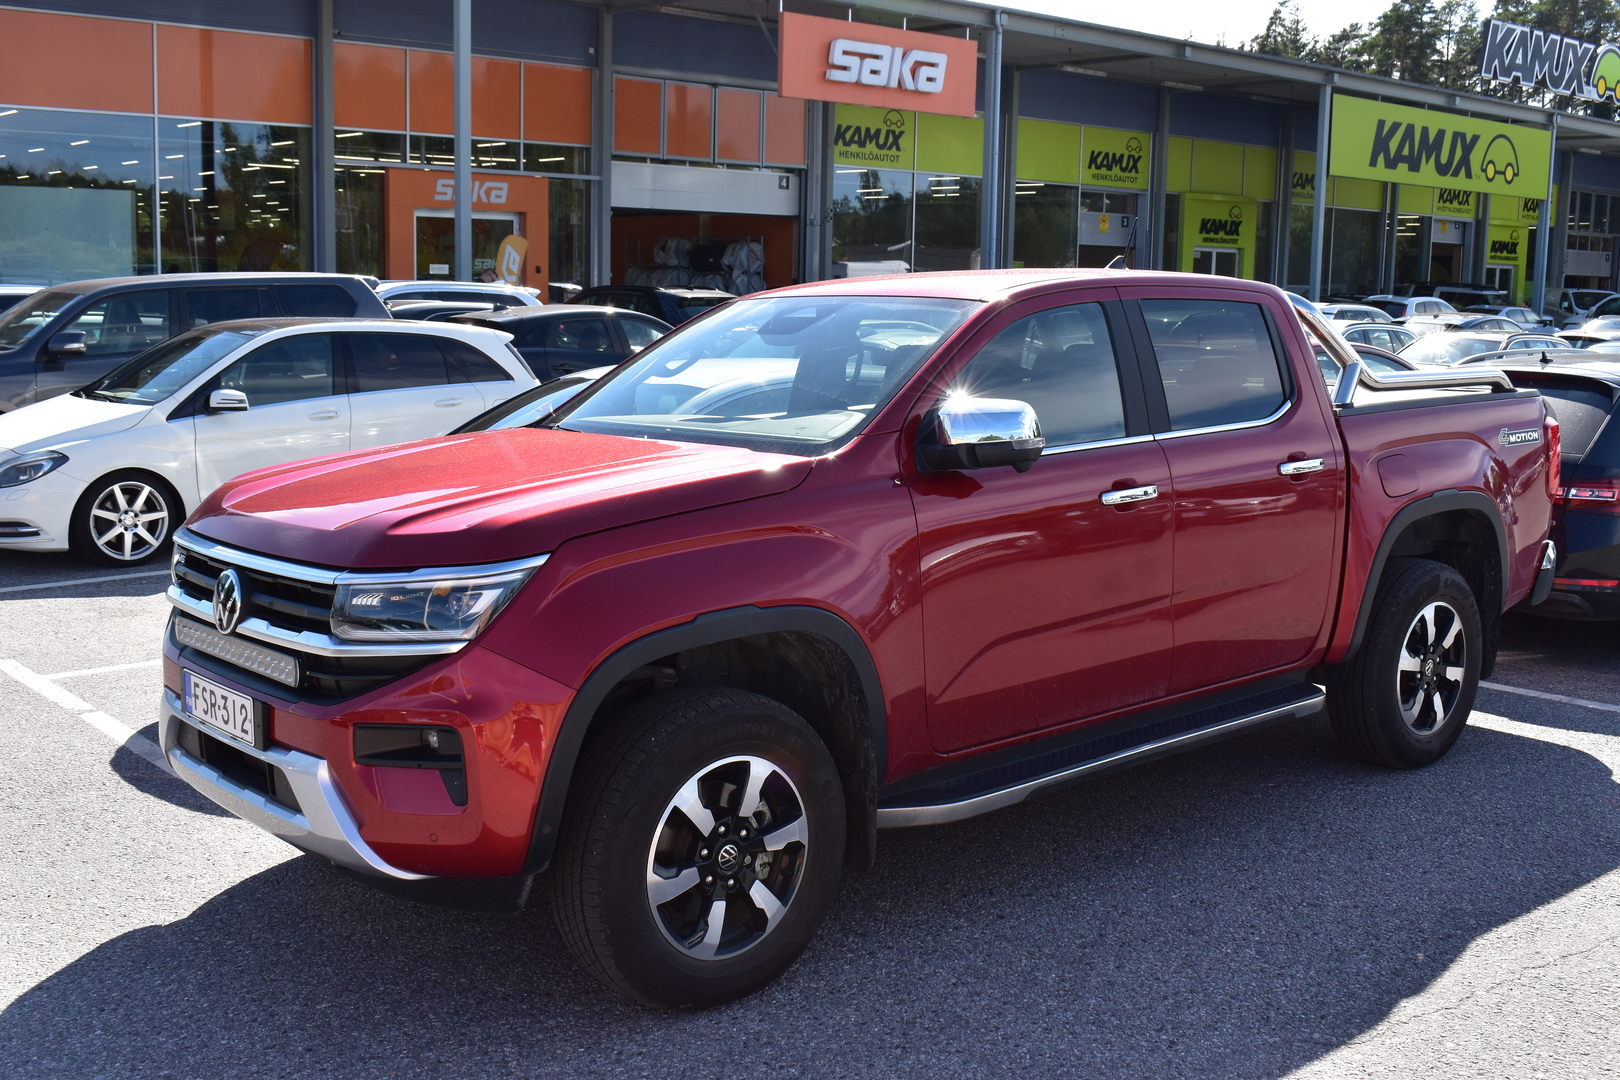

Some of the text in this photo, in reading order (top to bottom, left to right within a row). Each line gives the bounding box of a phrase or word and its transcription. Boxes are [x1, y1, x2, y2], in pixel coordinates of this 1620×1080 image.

[1481, 19, 1595, 95] KAMUX
[834, 124, 905, 152] KAMUX
[839, 150, 900, 163] HENKILÖAUTOT
[1368, 118, 1481, 180] KAMUX
[1088, 150, 1142, 174] KAMUX
[1091, 173, 1138, 184] HENKILÖAUTOT
[1438, 188, 1472, 206] KAMUX
[1199, 218, 1243, 237] KAMUX
[1490, 240, 1519, 255] KAMUX
[1498, 428, 1539, 445] 4MOTION
[192, 681, 249, 735] FSR-312
